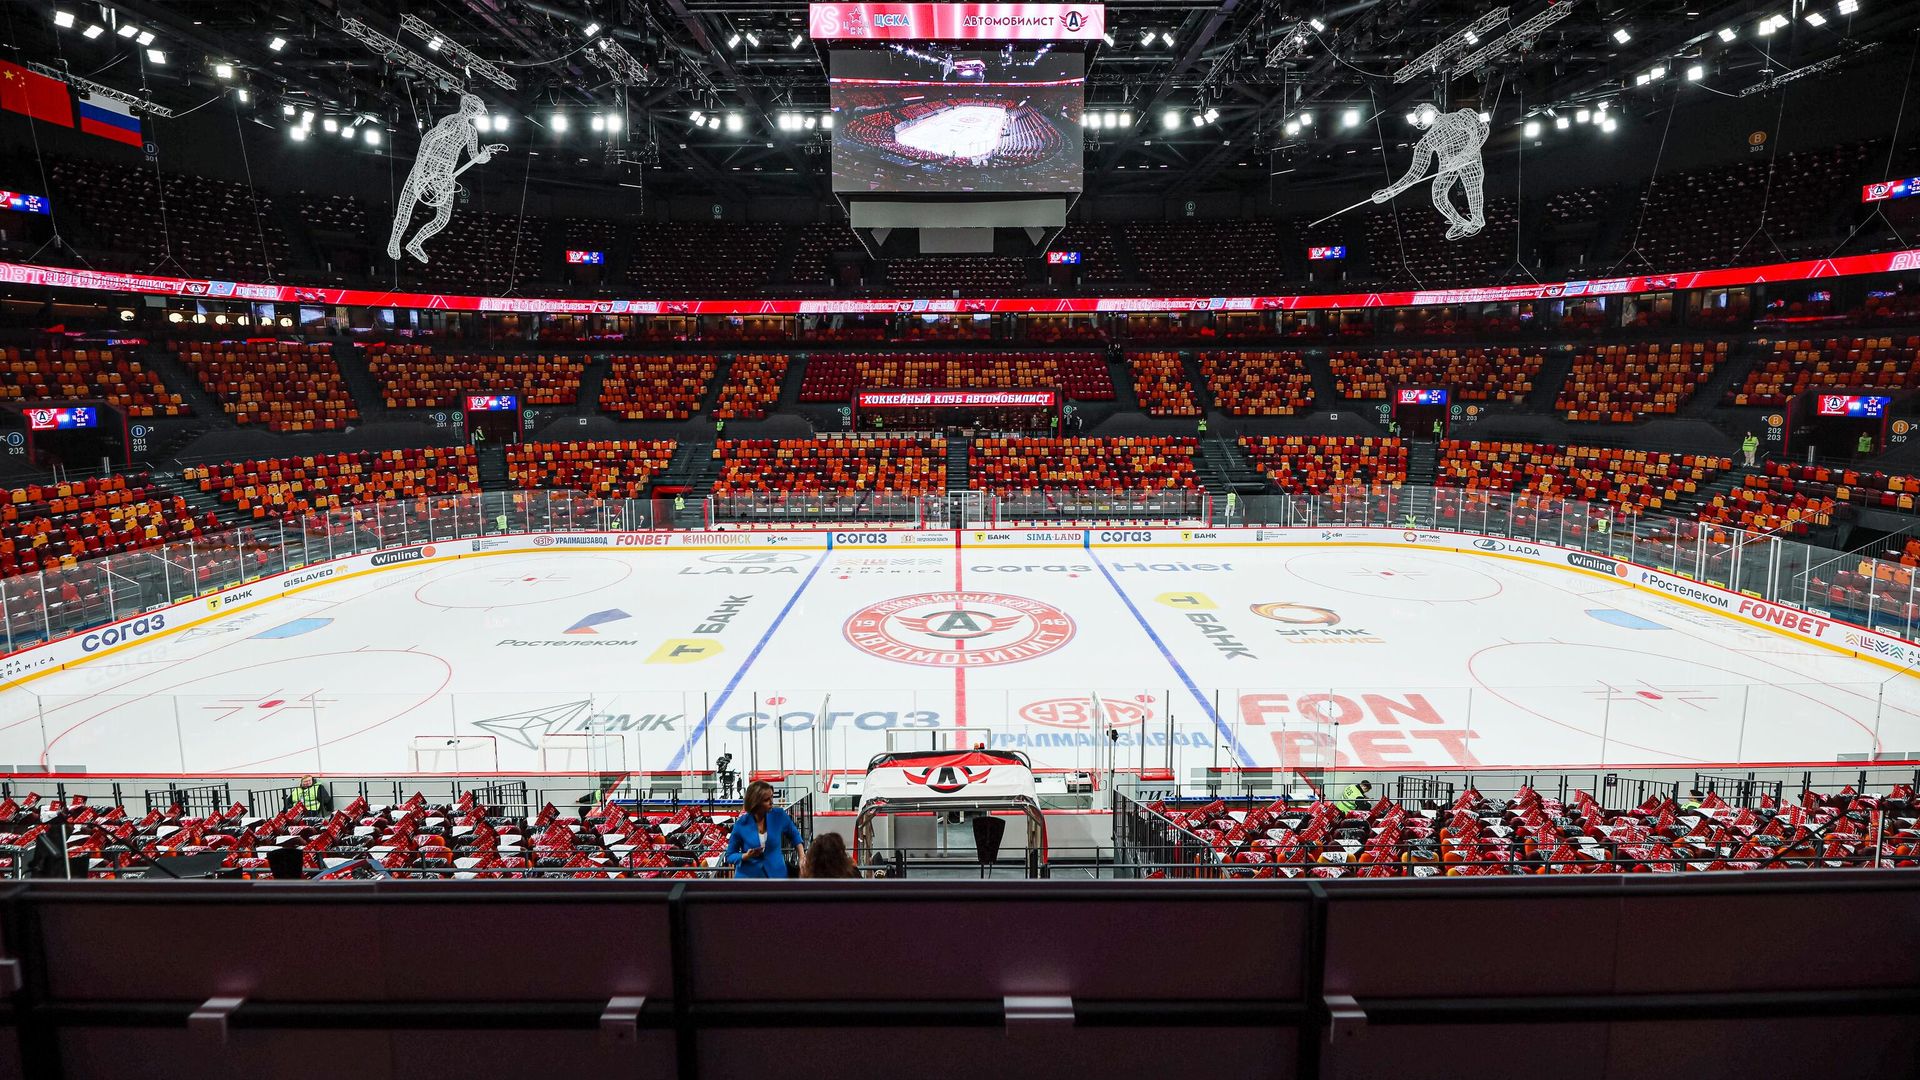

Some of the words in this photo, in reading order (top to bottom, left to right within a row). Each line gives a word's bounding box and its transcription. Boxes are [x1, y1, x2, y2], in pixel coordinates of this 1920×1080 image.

[874, 14, 910, 27] ЦСКА
[963, 16, 1054, 26] АВТОМОБИЛИСТ
[1750, 145, 1764, 153] 303
[864, 394, 931, 404] ХОККЕЙНЫЙ
[934, 395, 963, 404] КЛУБ
[965, 394, 1049, 405] АВТОМОБИЛИСТ
[1891, 435, 1907, 443] 202
[8, 447, 24, 455] 202
[133, 444, 148, 452] 202
[555, 536, 608, 545] УРАЛМАШЗАВОД
[616, 534, 672, 545] FONBET
[682, 534, 750, 545] КИНОПОИСК
[1508, 544, 1541, 556] LADA
[375, 551, 419, 564] Winline
[1570, 554, 1613, 572] Winline
[678, 566, 799, 575] LADA
[1111, 561, 1233, 572] Haier
[283, 568, 334, 588] GISLAVED
[1649, 574, 1729, 608] Ростелеком
[224, 589, 253, 605] БАНК
[1000, 598, 1050, 616] КЛУБ
[692, 594, 755, 634] БАНК
[1738, 599, 1831, 637] FONBET
[855, 619, 876, 627] 19
[1040, 618, 1066, 626] 46
[936, 611, 982, 632] А
[1185, 613, 1259, 660] БАНК
[496, 638, 640, 647] Ростелеком
[852, 630, 1066, 665] АВТОМОБИЛИСТ
